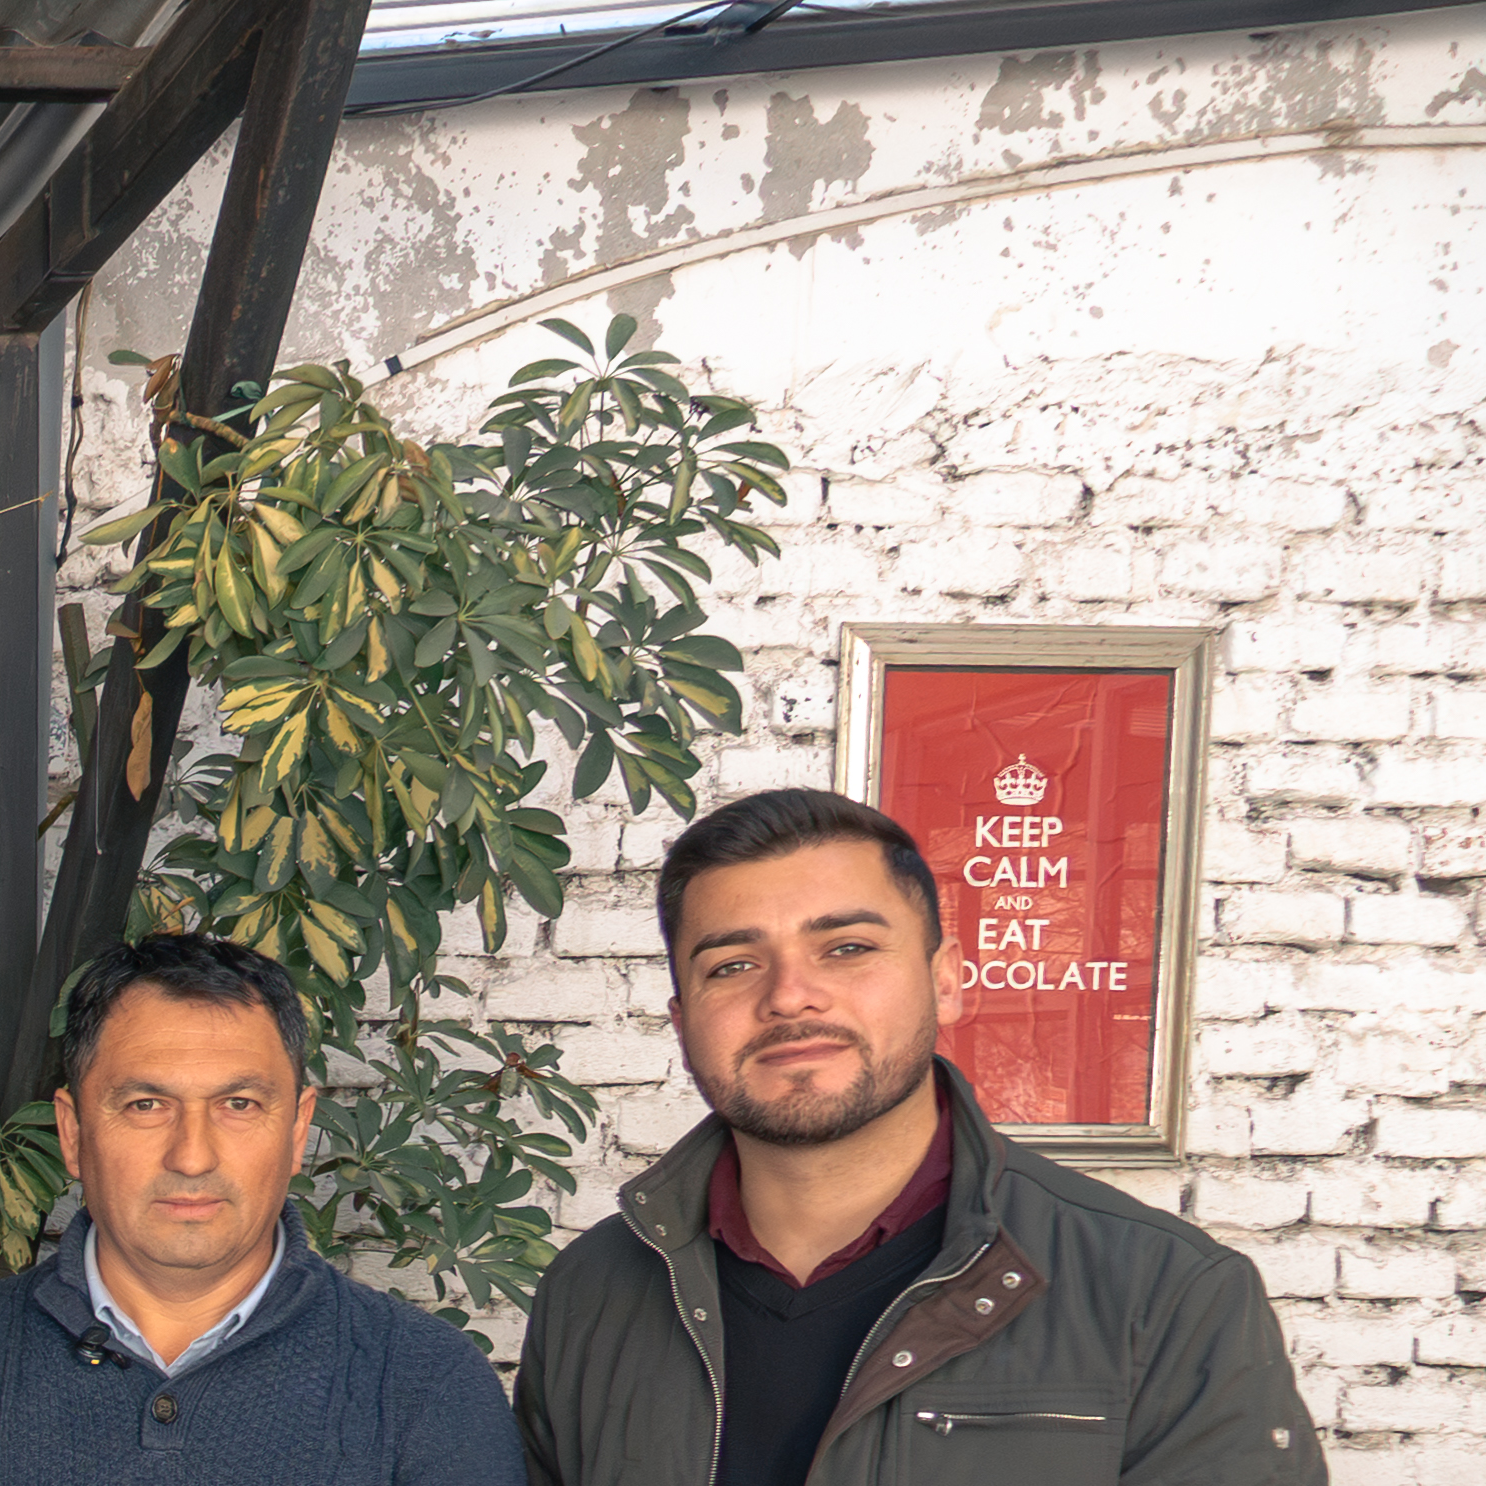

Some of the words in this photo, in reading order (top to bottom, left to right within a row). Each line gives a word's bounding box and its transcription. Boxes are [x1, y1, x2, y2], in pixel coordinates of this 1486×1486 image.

[975, 815, 1063, 848] KEEP
[962, 855, 1068, 888] CALM
[994, 896, 1034, 910] AND
[978, 918, 1050, 951] EAT
[961, 960, 1128, 991] OCOLATE
